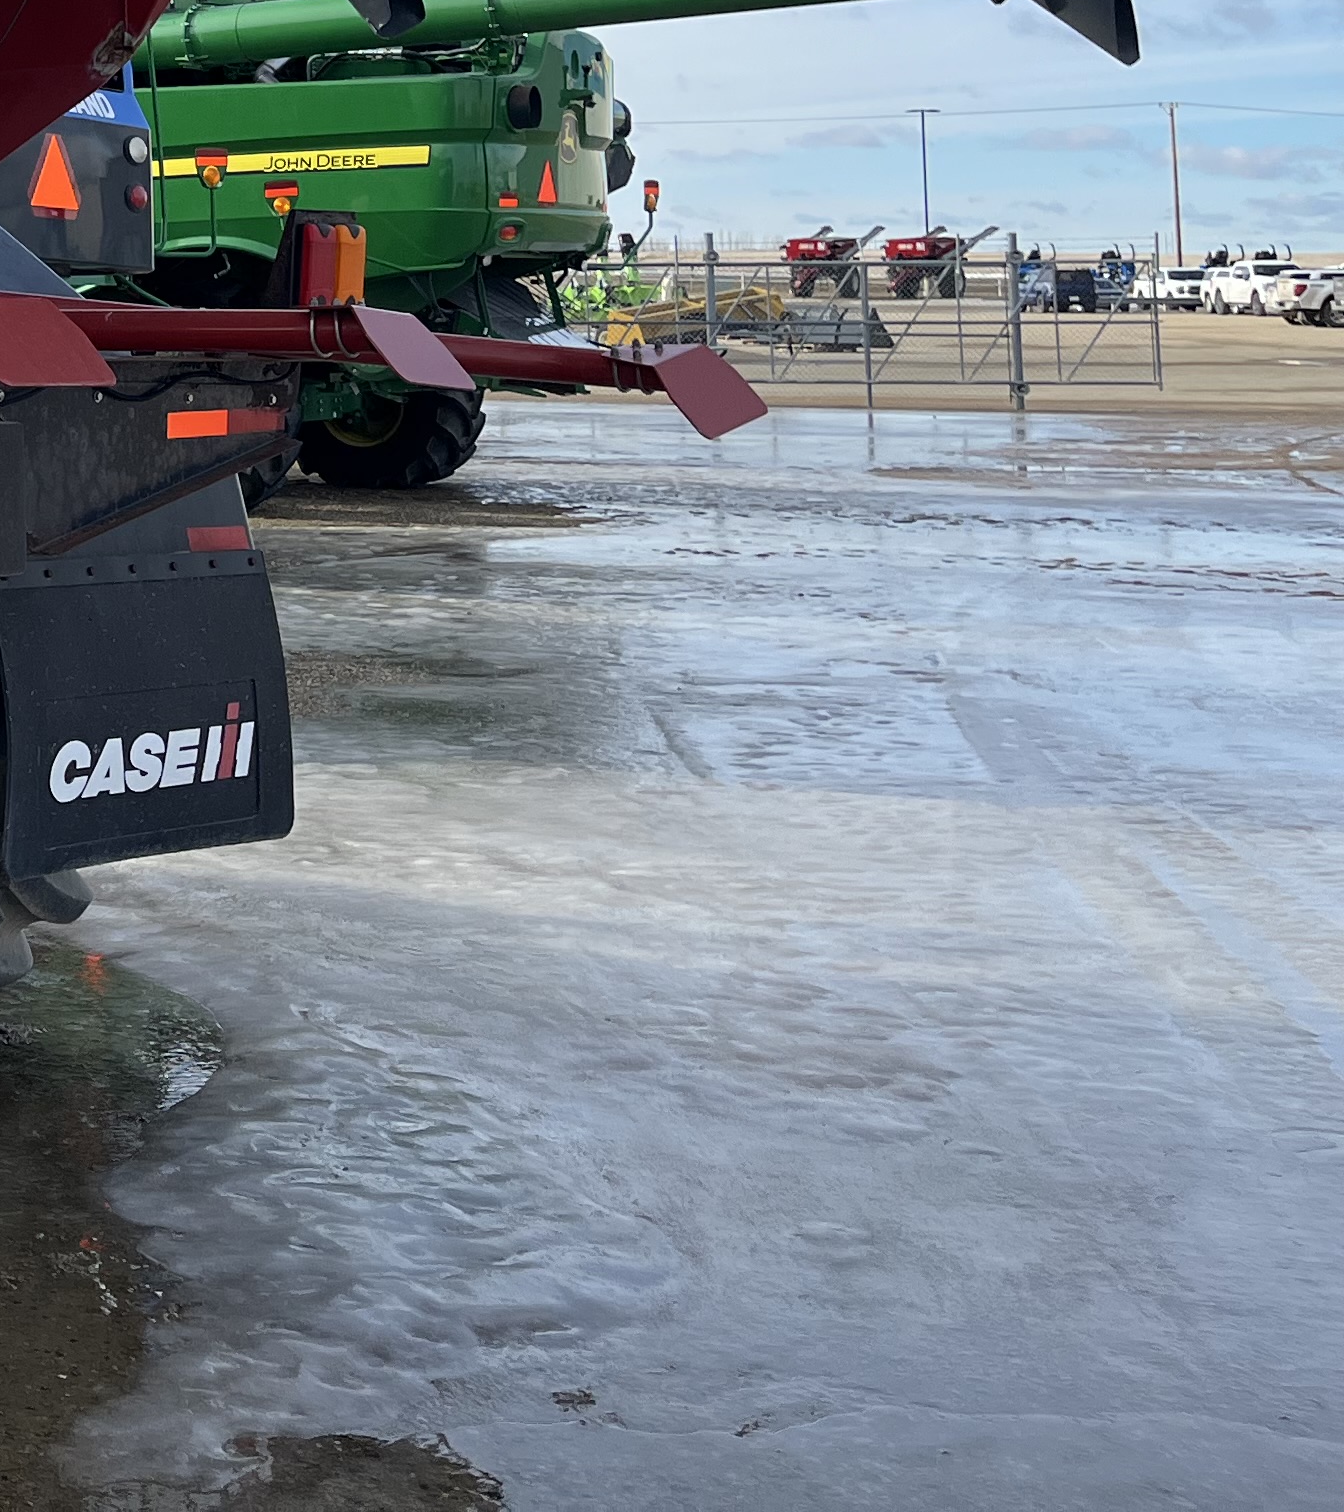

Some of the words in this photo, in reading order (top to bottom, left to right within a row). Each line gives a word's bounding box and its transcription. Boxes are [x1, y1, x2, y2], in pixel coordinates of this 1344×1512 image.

[263, 155, 312, 170] JOHN
[316, 152, 377, 169] DEERE
[49, 727, 201, 803] CASE
